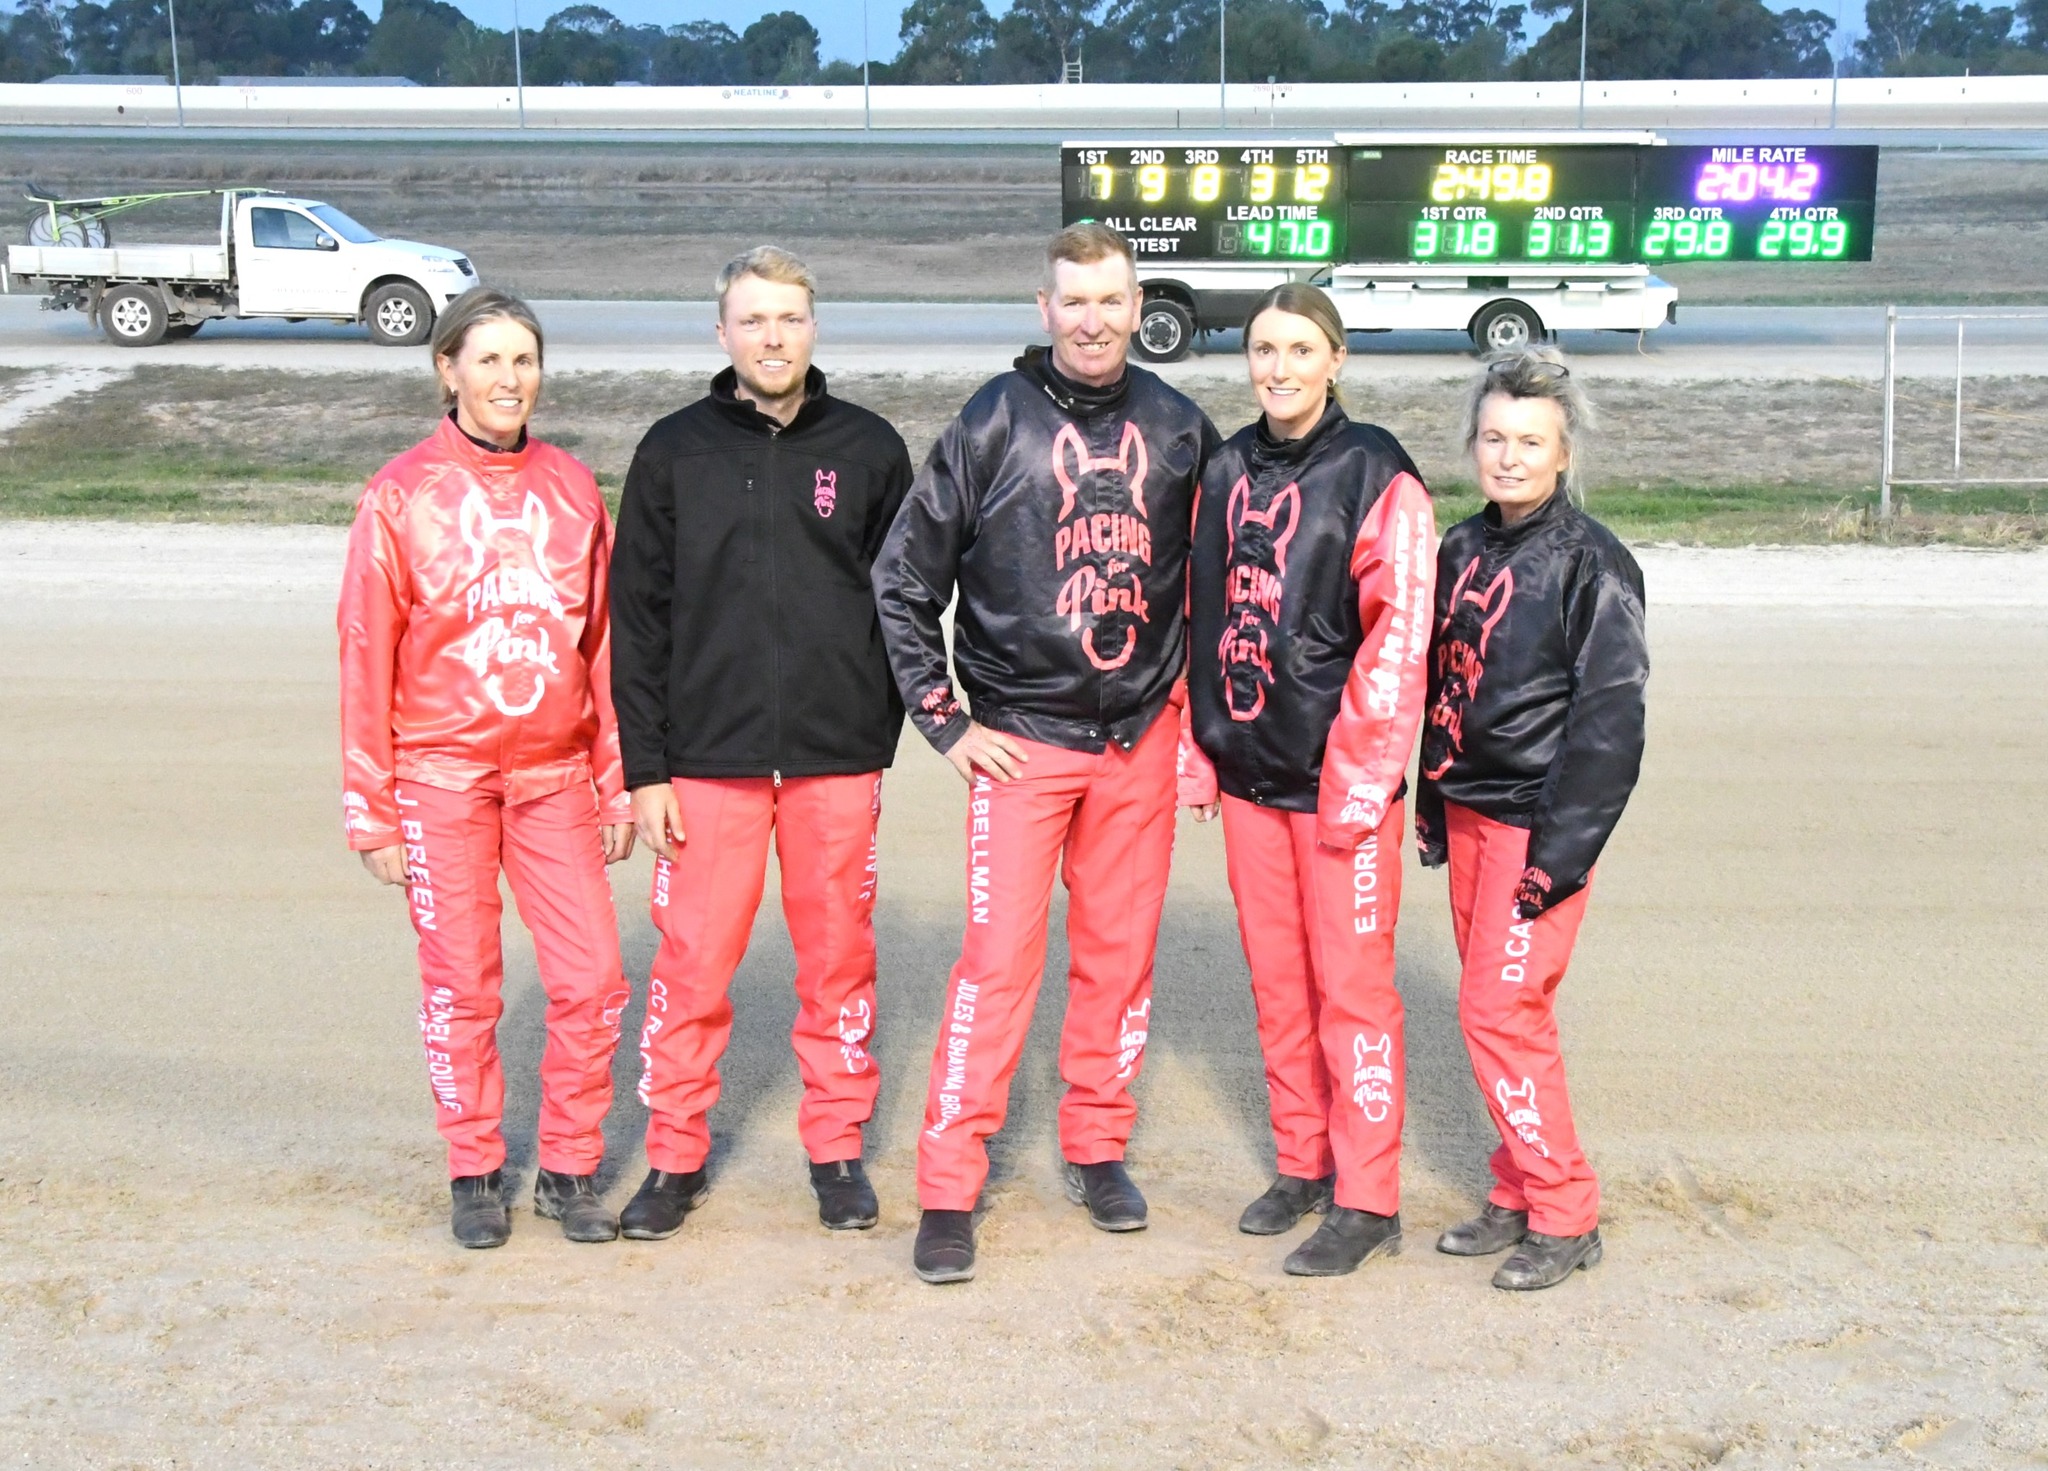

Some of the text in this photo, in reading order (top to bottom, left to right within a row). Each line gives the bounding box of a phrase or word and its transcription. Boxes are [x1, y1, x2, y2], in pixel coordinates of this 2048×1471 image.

[733, 88, 778, 96] NEATLINE
[1077, 150, 1108, 165] 1ST
[1130, 150, 1165, 165] 2ND
[1185, 150, 1219, 164] 3RD
[1240, 149, 1274, 164] 4TH
[1296, 149, 1328, 164] 5TH
[1445, 149, 1537, 164] RACE TIME
[1712, 148, 1806, 163] MILE RATE
[1089, 165, 1112, 200] 7
[1140, 165, 1167, 201] 9
[1193, 165, 1221, 201] 8
[1250, 165, 1275, 201] 3
[1294, 165, 1330, 201] 12
[1105, 217, 1197, 231] ALL CLEAR
[1227, 206, 1317, 221] LEAD TIME
[1421, 207, 1487, 221] 1ST QTR
[1534, 206, 1603, 221] 2ND QTR
[1653, 207, 1722, 221] 3RD QTR
[1770, 206, 1838, 221] 4TH QTR
[1128, 238, 1180, 252] OTEST
[1248, 222, 1331, 256] 47.0
[1414, 222, 1497, 256] 31.8
[1528, 222, 1612, 256] 31.3
[1644, 222, 1730, 256] 29.8
[1758, 222, 1846, 256] 29.9
[1055, 513, 1152, 571] PACING
[1106, 558, 1130, 579] for
[467, 567, 563, 622] PACING
[1056, 565, 1149, 632] Pink
[512, 610, 536, 628] for
[1239, 609, 1261, 630] for
[463, 616, 560, 678] Pink
[970, 774, 993, 924] M.BELLMAN
[651, 978, 668, 1012] CC
[952, 978, 980, 1023] JULES
[950, 1023, 972, 1034] &
[941, 1036, 969, 1091] SHANNA
[1353, 1065, 1393, 1087] PACING
[1353, 1083, 1393, 1108] Pink
